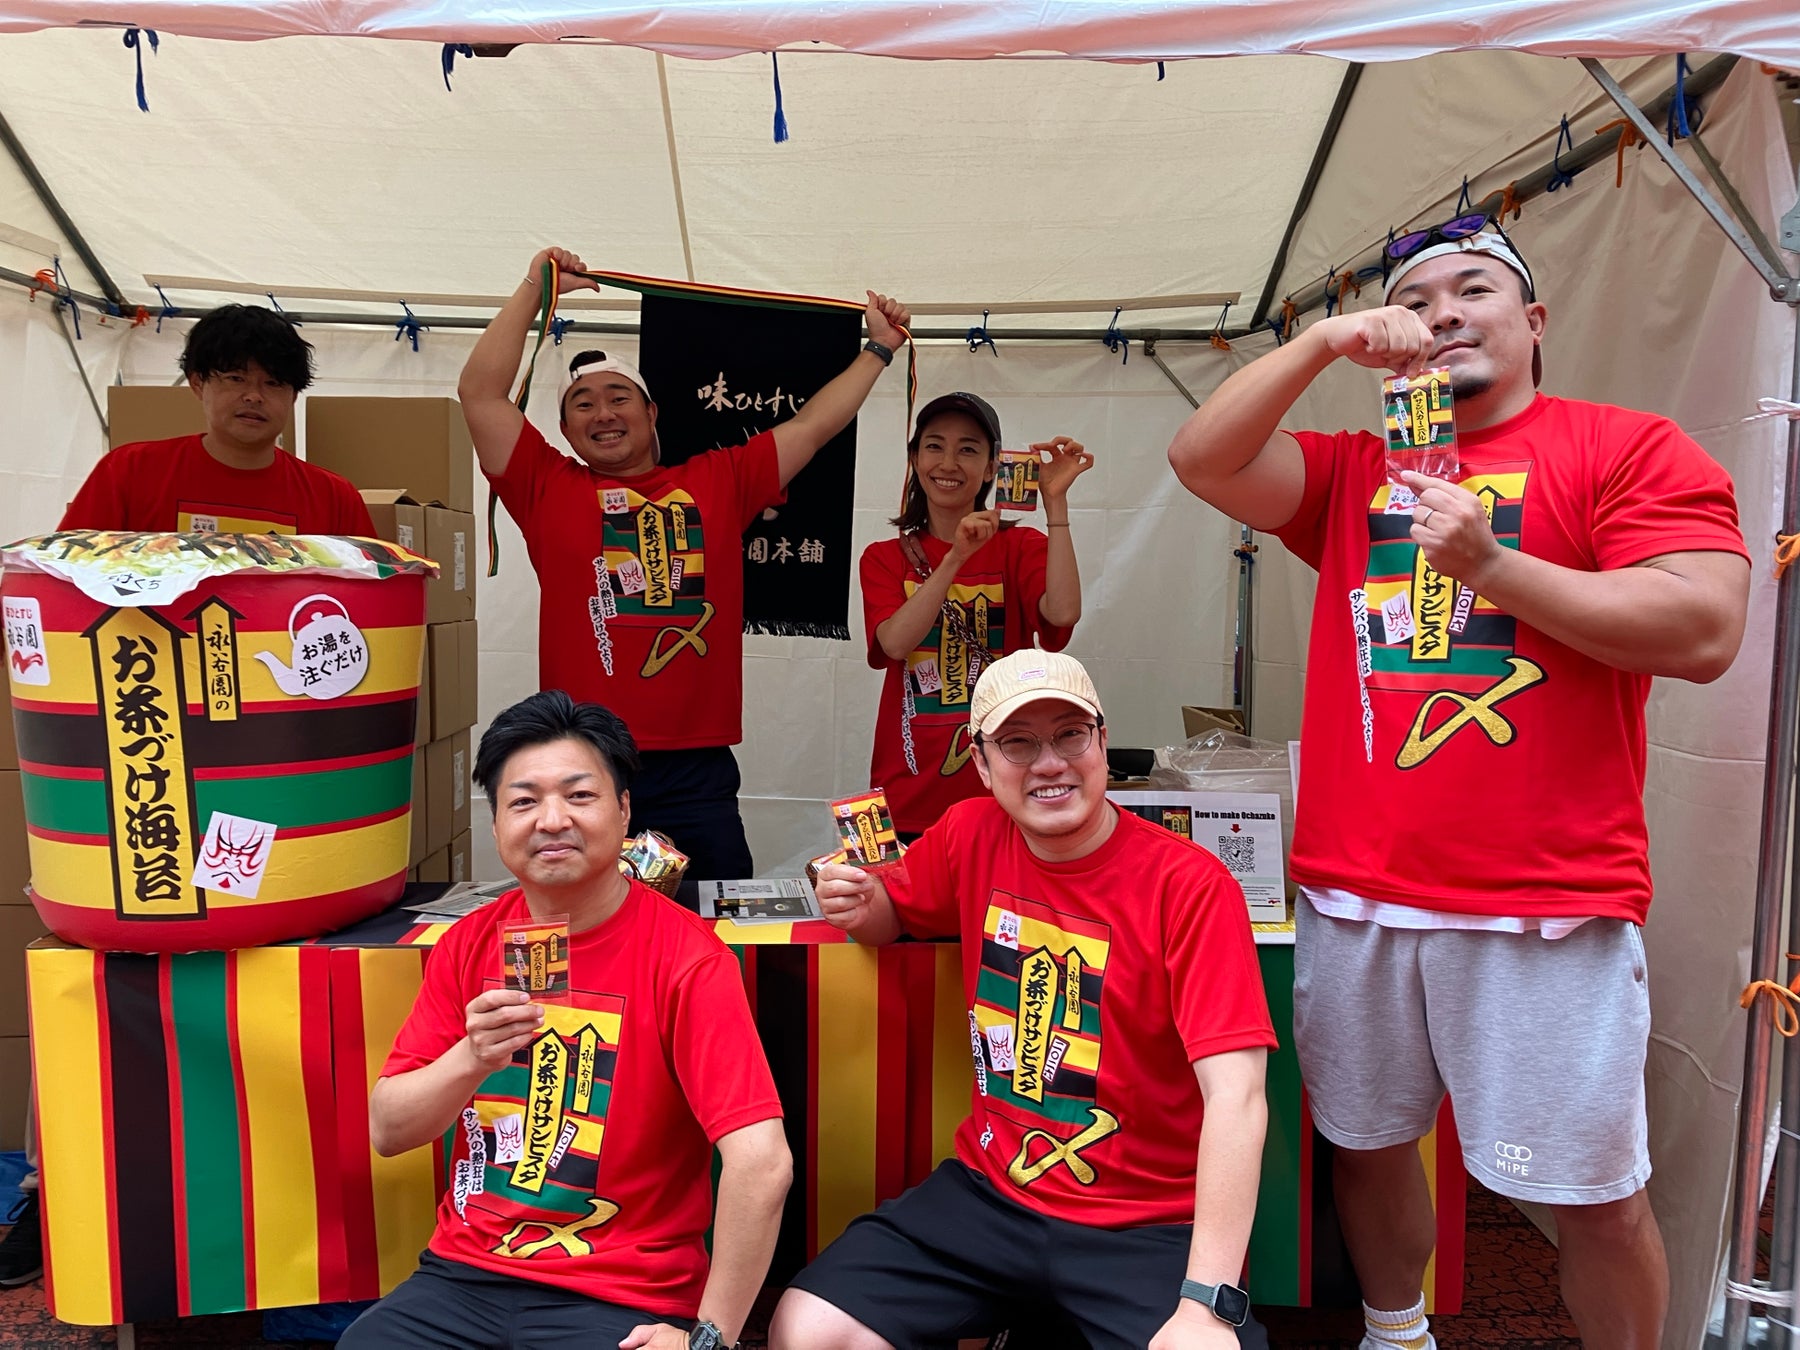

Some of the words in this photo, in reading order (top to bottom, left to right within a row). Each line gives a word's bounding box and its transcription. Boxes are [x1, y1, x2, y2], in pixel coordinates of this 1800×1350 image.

[697, 371, 805, 418] 味ひとすじ
[594, 558, 615, 617] サンバの熱狂は
[642, 510, 668, 604] お茶づけサンビスタ
[742, 536, 825, 564] 園本舗
[301, 630, 351, 661] お湯を
[1419, 564, 1446, 657] けサンビスタ
[205, 623, 233, 711] 永谷園の
[299, 645, 363, 687] 注ぐだけ
[945, 622, 963, 702] 茶づけサンビスタ
[112, 634, 182, 902] お茶づけ海苔
[1195, 811, 1210, 819] How
[1211, 811, 1219, 819] to
[1220, 811, 1240, 819] make
[1018, 958, 1052, 1093] お茶づけサンビスタ
[464, 1110, 484, 1192] サンバの熱狂は
[518, 1041, 561, 1185] お茶づけサンビスタ
[1496, 1159, 1529, 1176] MiPE
